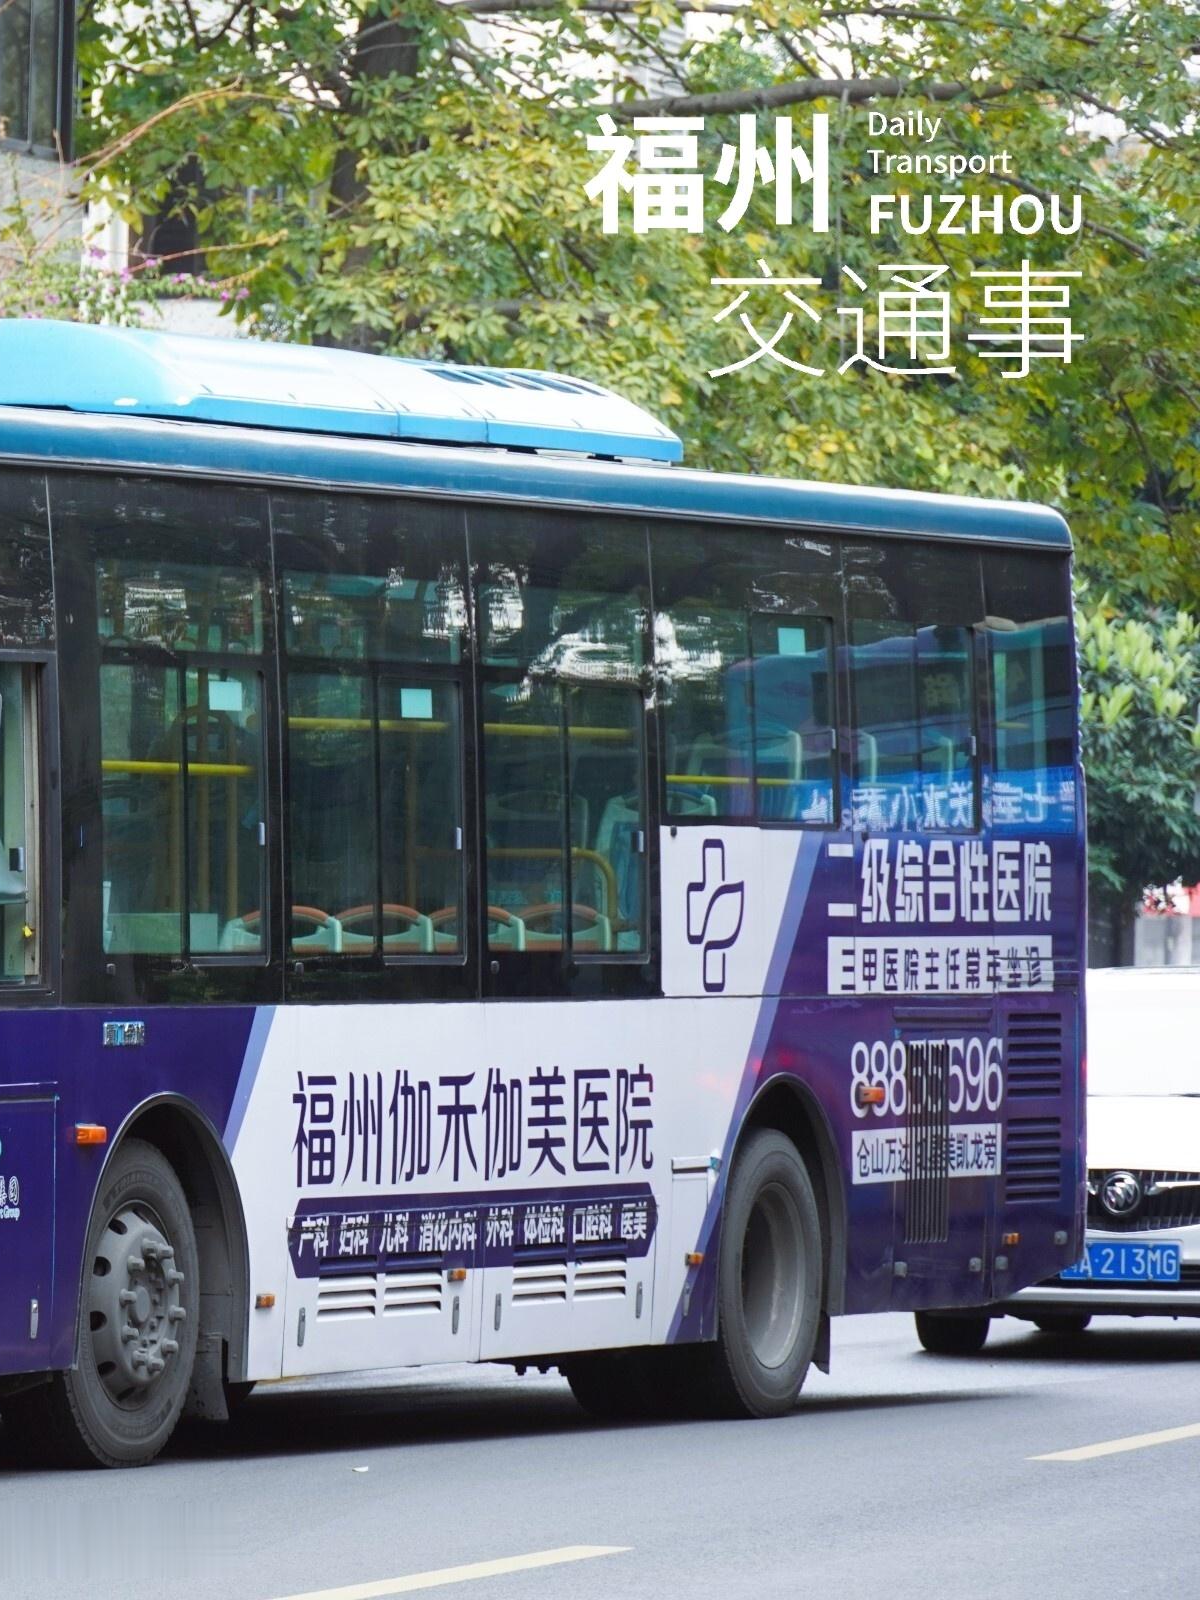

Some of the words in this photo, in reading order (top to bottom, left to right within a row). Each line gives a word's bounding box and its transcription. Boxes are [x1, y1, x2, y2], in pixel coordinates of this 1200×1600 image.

[827, 838, 1052, 923] 二级综合性医院
[840, 946, 1042, 991] 三甲医院主任常年坐诊
[291, 1063, 654, 1188] 福州伽禾伽美医院
